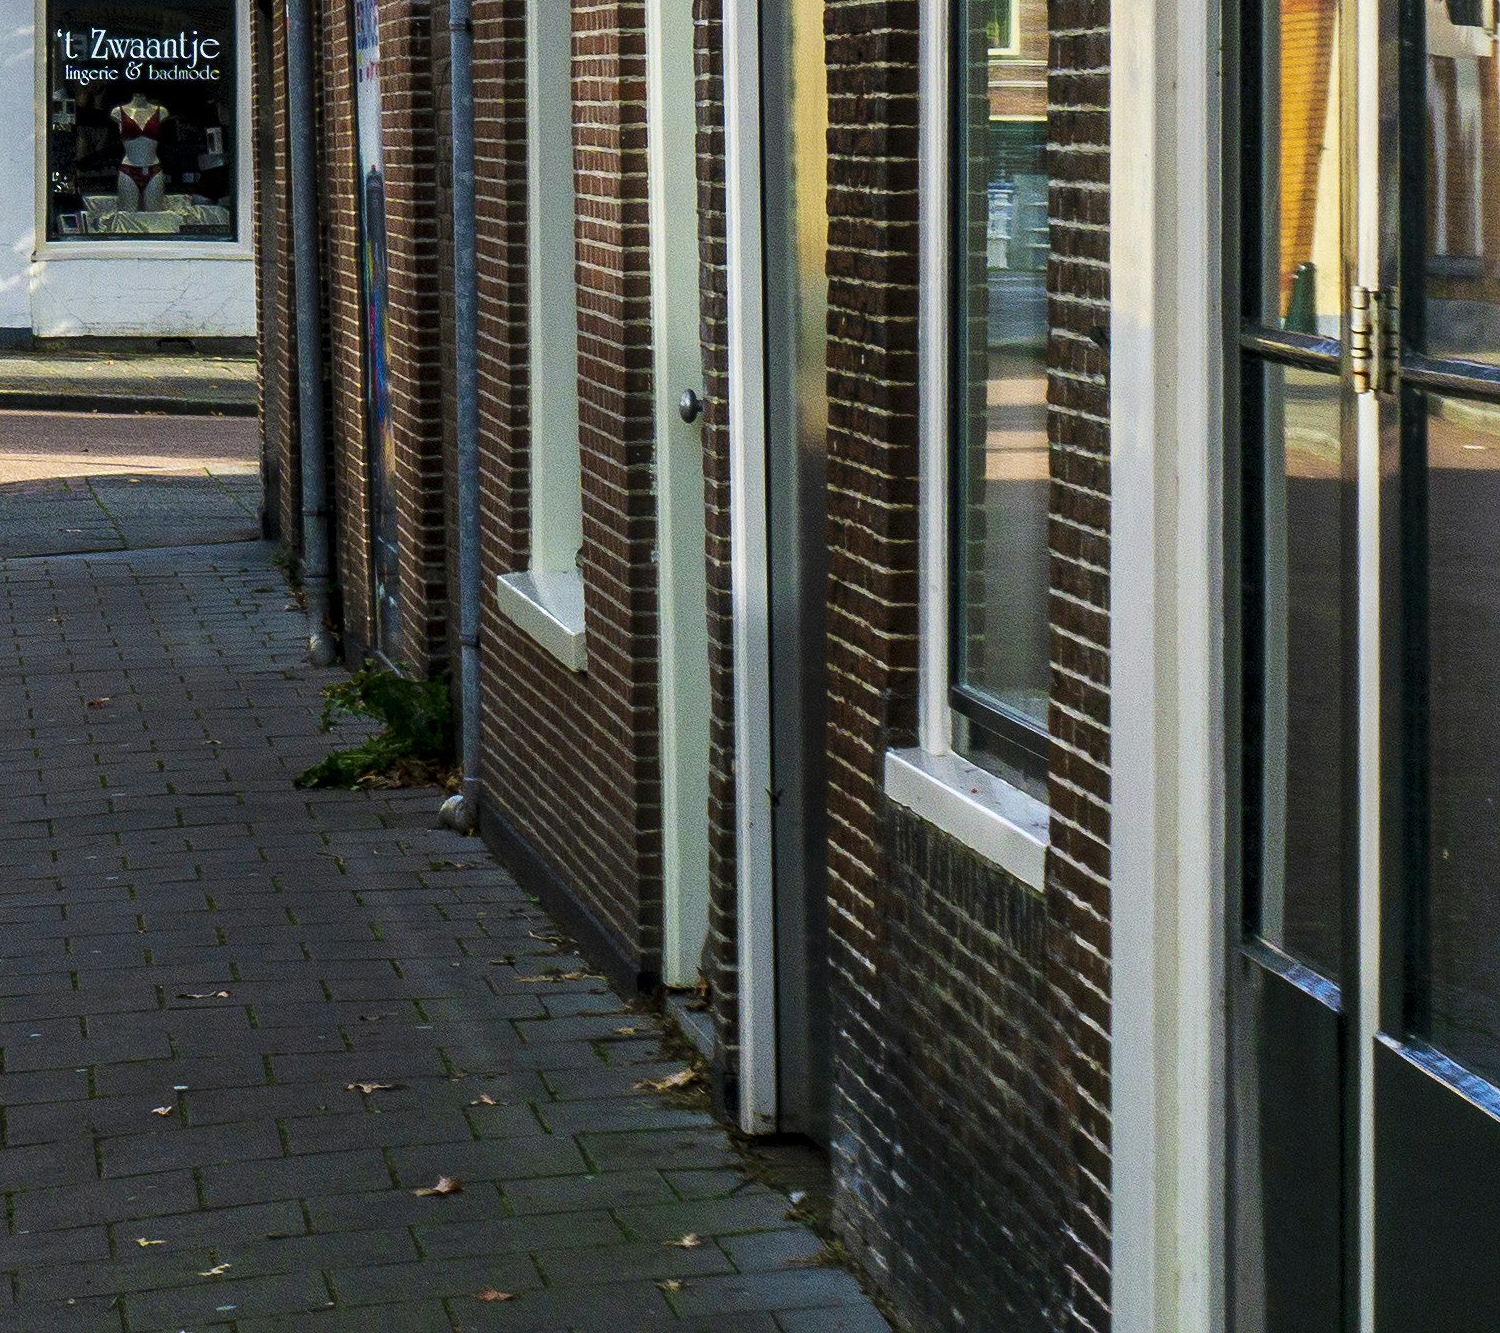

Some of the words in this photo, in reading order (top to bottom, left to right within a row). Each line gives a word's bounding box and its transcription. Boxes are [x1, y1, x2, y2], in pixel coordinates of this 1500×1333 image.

[91, 27, 220, 69] Zwaantje
[65, 65, 119, 85] lingerie
[125, 61, 144, 80] &
[149, 65, 221, 81] badmode
